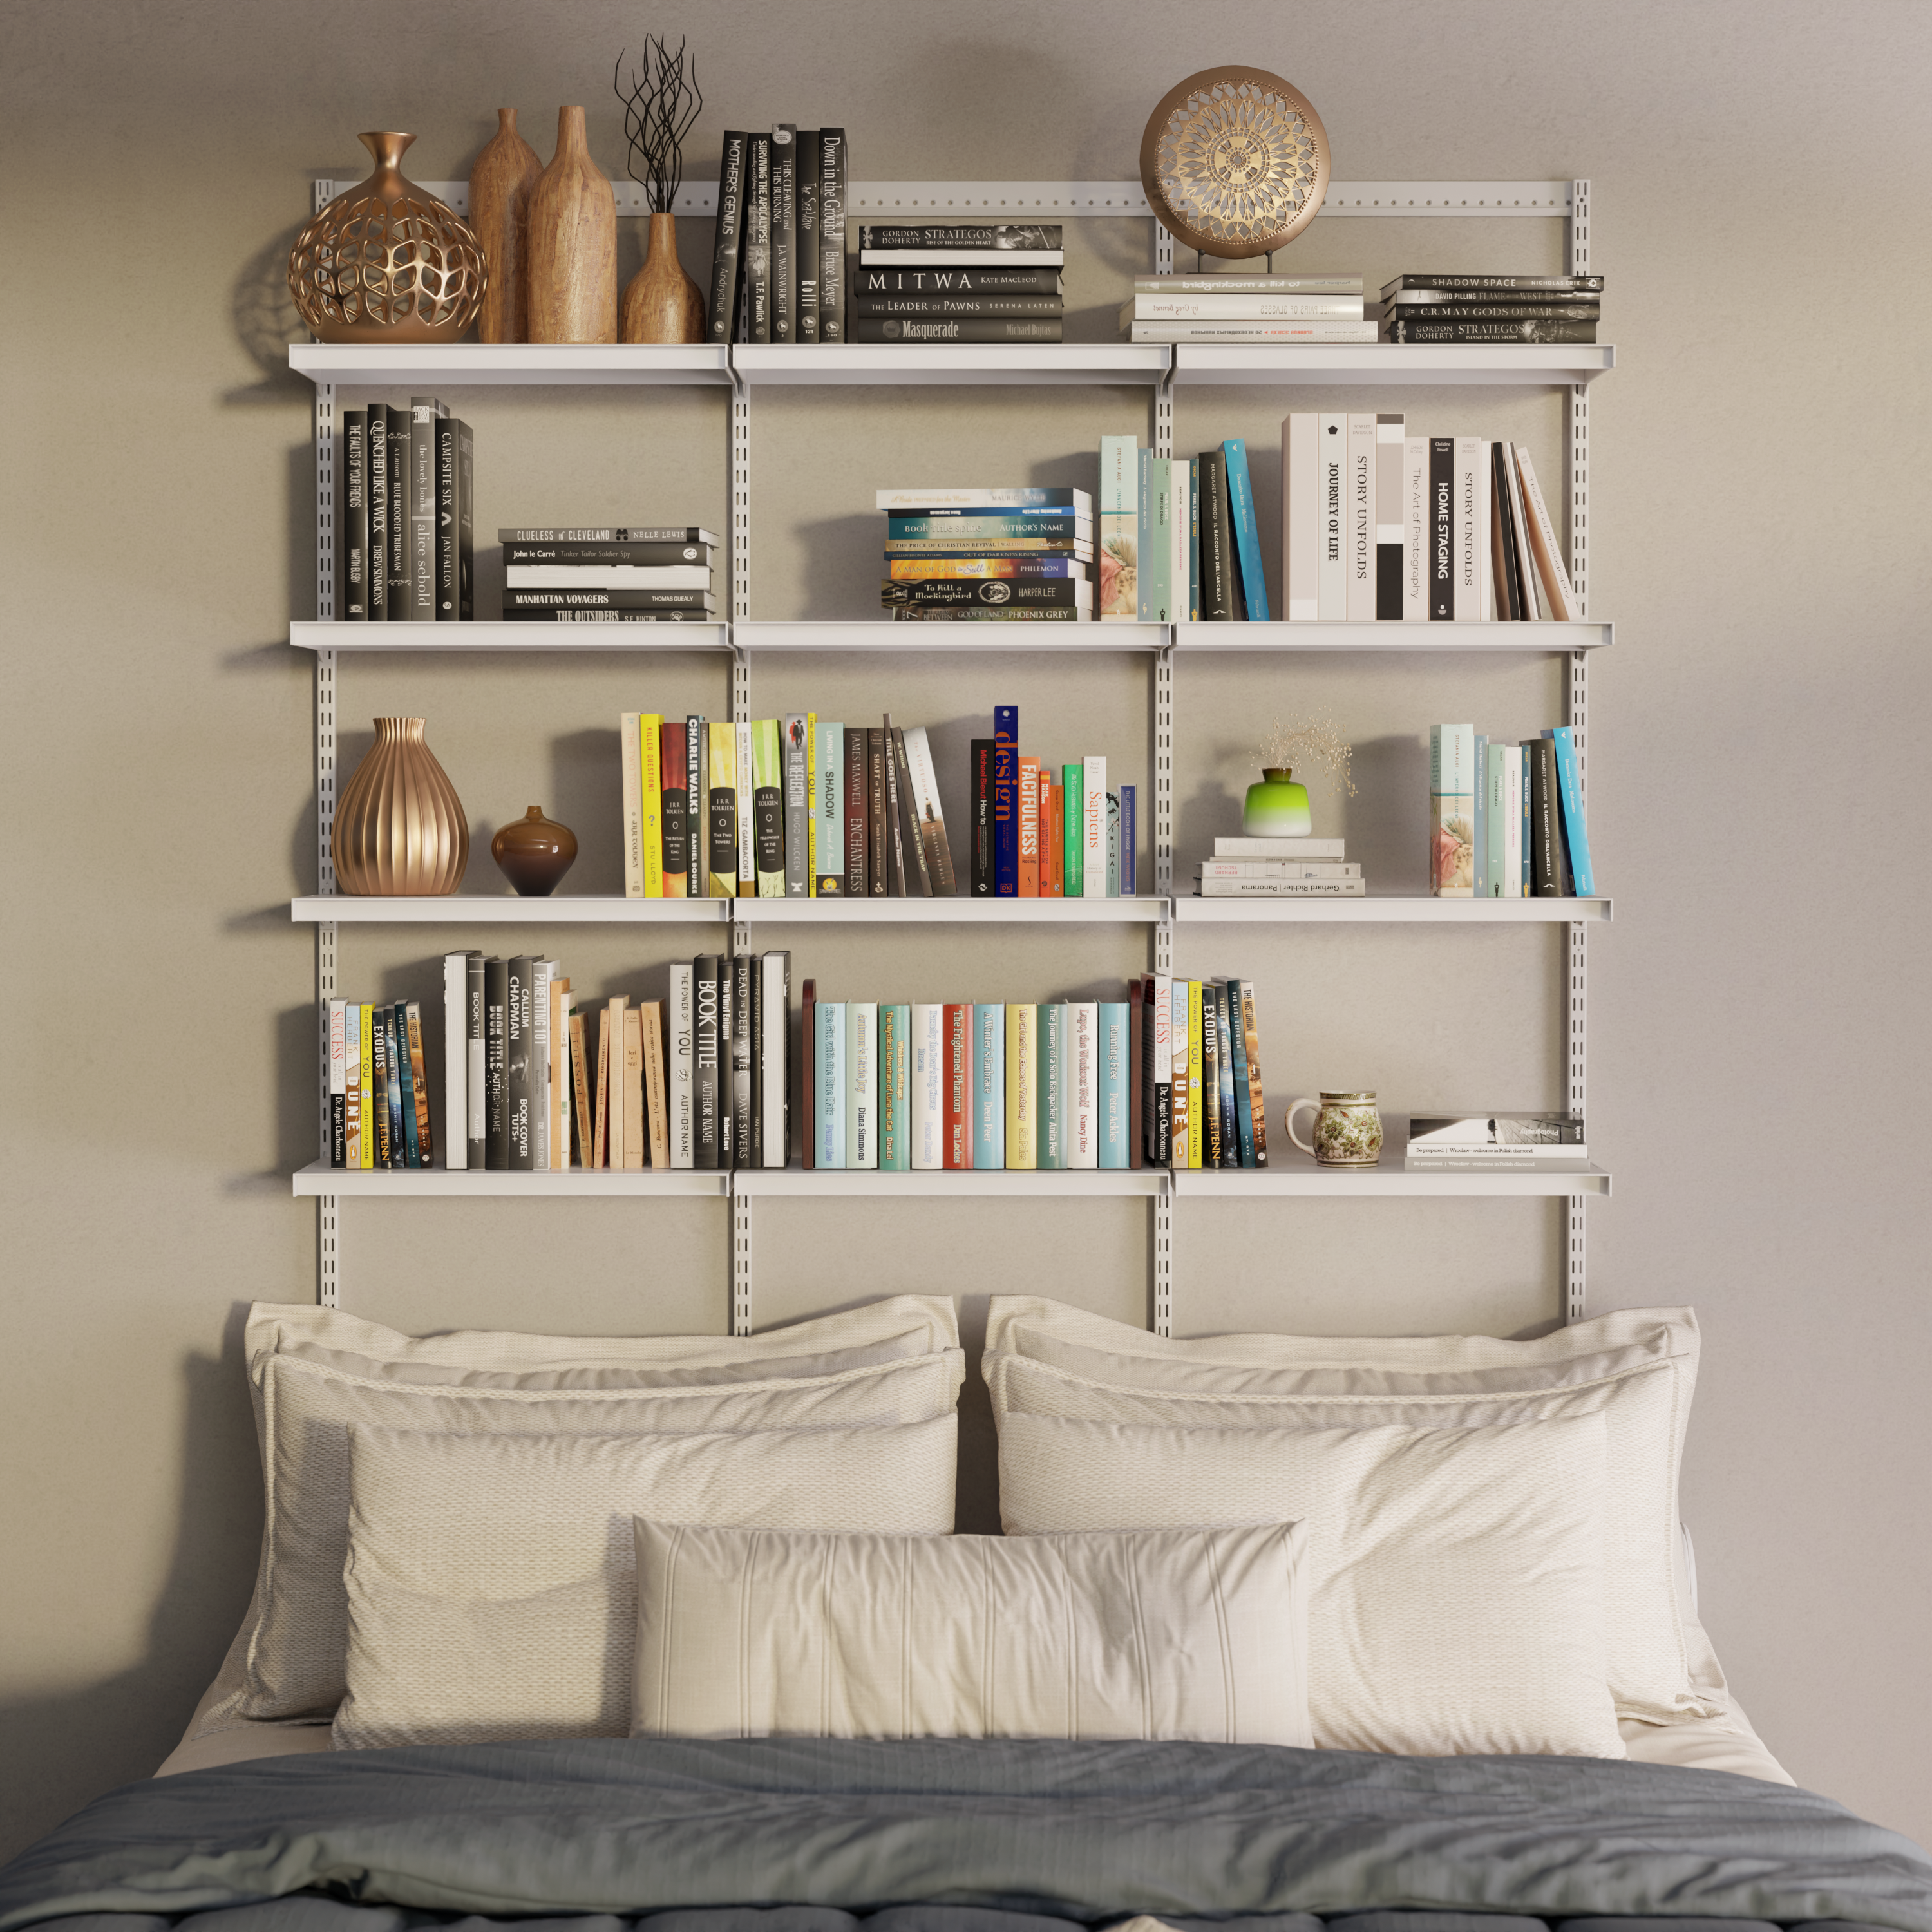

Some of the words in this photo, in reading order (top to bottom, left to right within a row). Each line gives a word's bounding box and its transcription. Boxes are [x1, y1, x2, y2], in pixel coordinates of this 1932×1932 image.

[726, 139, 741, 193] MOTHER'S
[759, 140, 767, 178] SURVIVING
[825, 137, 840, 166] Down
[759, 180, 767, 194] THE
[825, 167, 840, 178] in
[825, 182, 842, 197] the
[722, 196, 736, 234] GENIUS
[759, 196, 768, 243] APOCALYPSE
[825, 200, 842, 236] Ground
[925, 229, 992, 239] STRATEGOS
[826, 251, 839, 275] Bruce
[717, 268, 728, 312] Andrychuk
[802, 281, 817, 307] Rolli
[822, 278, 839, 305] Meyer
[903, 321, 958, 339] Masquerade
[1006, 324, 1030, 336] Michael
[1032, 324, 1050, 336] Bujtas
[370, 421, 384, 473] QUENCHED
[442, 433, 451, 486] CAMPSITE
[374, 476, 384, 493] LIKE
[417, 460, 427, 484] lovely
[1329, 463, 1338, 516] JOURNEY
[1357, 456, 1367, 504] STORY
[442, 489, 451, 506] SIX
[1438, 483, 1448, 522] HOME
[374, 506, 384, 533] WICK
[1329, 520, 1338, 534] OF
[1413, 512, 1421, 524] of
[418, 524, 430, 556] alice
[513, 551, 528, 559] John
[620, 551, 630, 559] Spy
[1329, 538, 1338, 561] LIFE
[1357, 509, 1367, 579] UNFOLDS
[1438, 525, 1448, 579] STAGING
[1411, 527, 1420, 598] Photography
[418, 559, 430, 606] sebold
[567, 595, 609, 603] VOYAGERS
[1019, 588, 1041, 597] HARPER
[1043, 587, 1056, 597] LEE
[689, 719, 698, 771] CHARLIE
[851, 734, 860, 761] JAMES
[689, 773, 698, 814] WALKS
[852, 764, 860, 806] MAXWELL
[996, 732, 1018, 820] design
[826, 772, 834, 819] SHADOW
[1021, 765, 1037, 855] FACTFULNESS
[1086, 792, 1102, 848] Sapiens
[851, 818, 862, 891] ENCHANTRESS
[739, 968, 747, 998] DEAD
[510, 976, 519, 1039] CHAPMAN
[699, 981, 716, 1027] BOOK
[954, 1010, 963, 1027] The
[331, 1012, 343, 1059] SUCCESS
[410, 1022, 419, 1048] HISTORIAN
[739, 1011, 747, 1037] DEEP
[1204, 1005, 1216, 1054] EXODUS
[374, 1026, 384, 1068] EXODUS
[699, 1030, 716, 1068] TITLE
[739, 1040, 747, 1077] WATER
[951, 1028, 963, 1074] Frightened
[1107, 1025, 1120, 1060] Running
[1110, 1062, 1119, 1080] Free
[348, 1077, 359, 1130] DUNE
[954, 1076, 963, 1112] Phantom
[334, 1107, 343, 1124] Angele
[1078, 1115, 1087, 1135] Nancy
